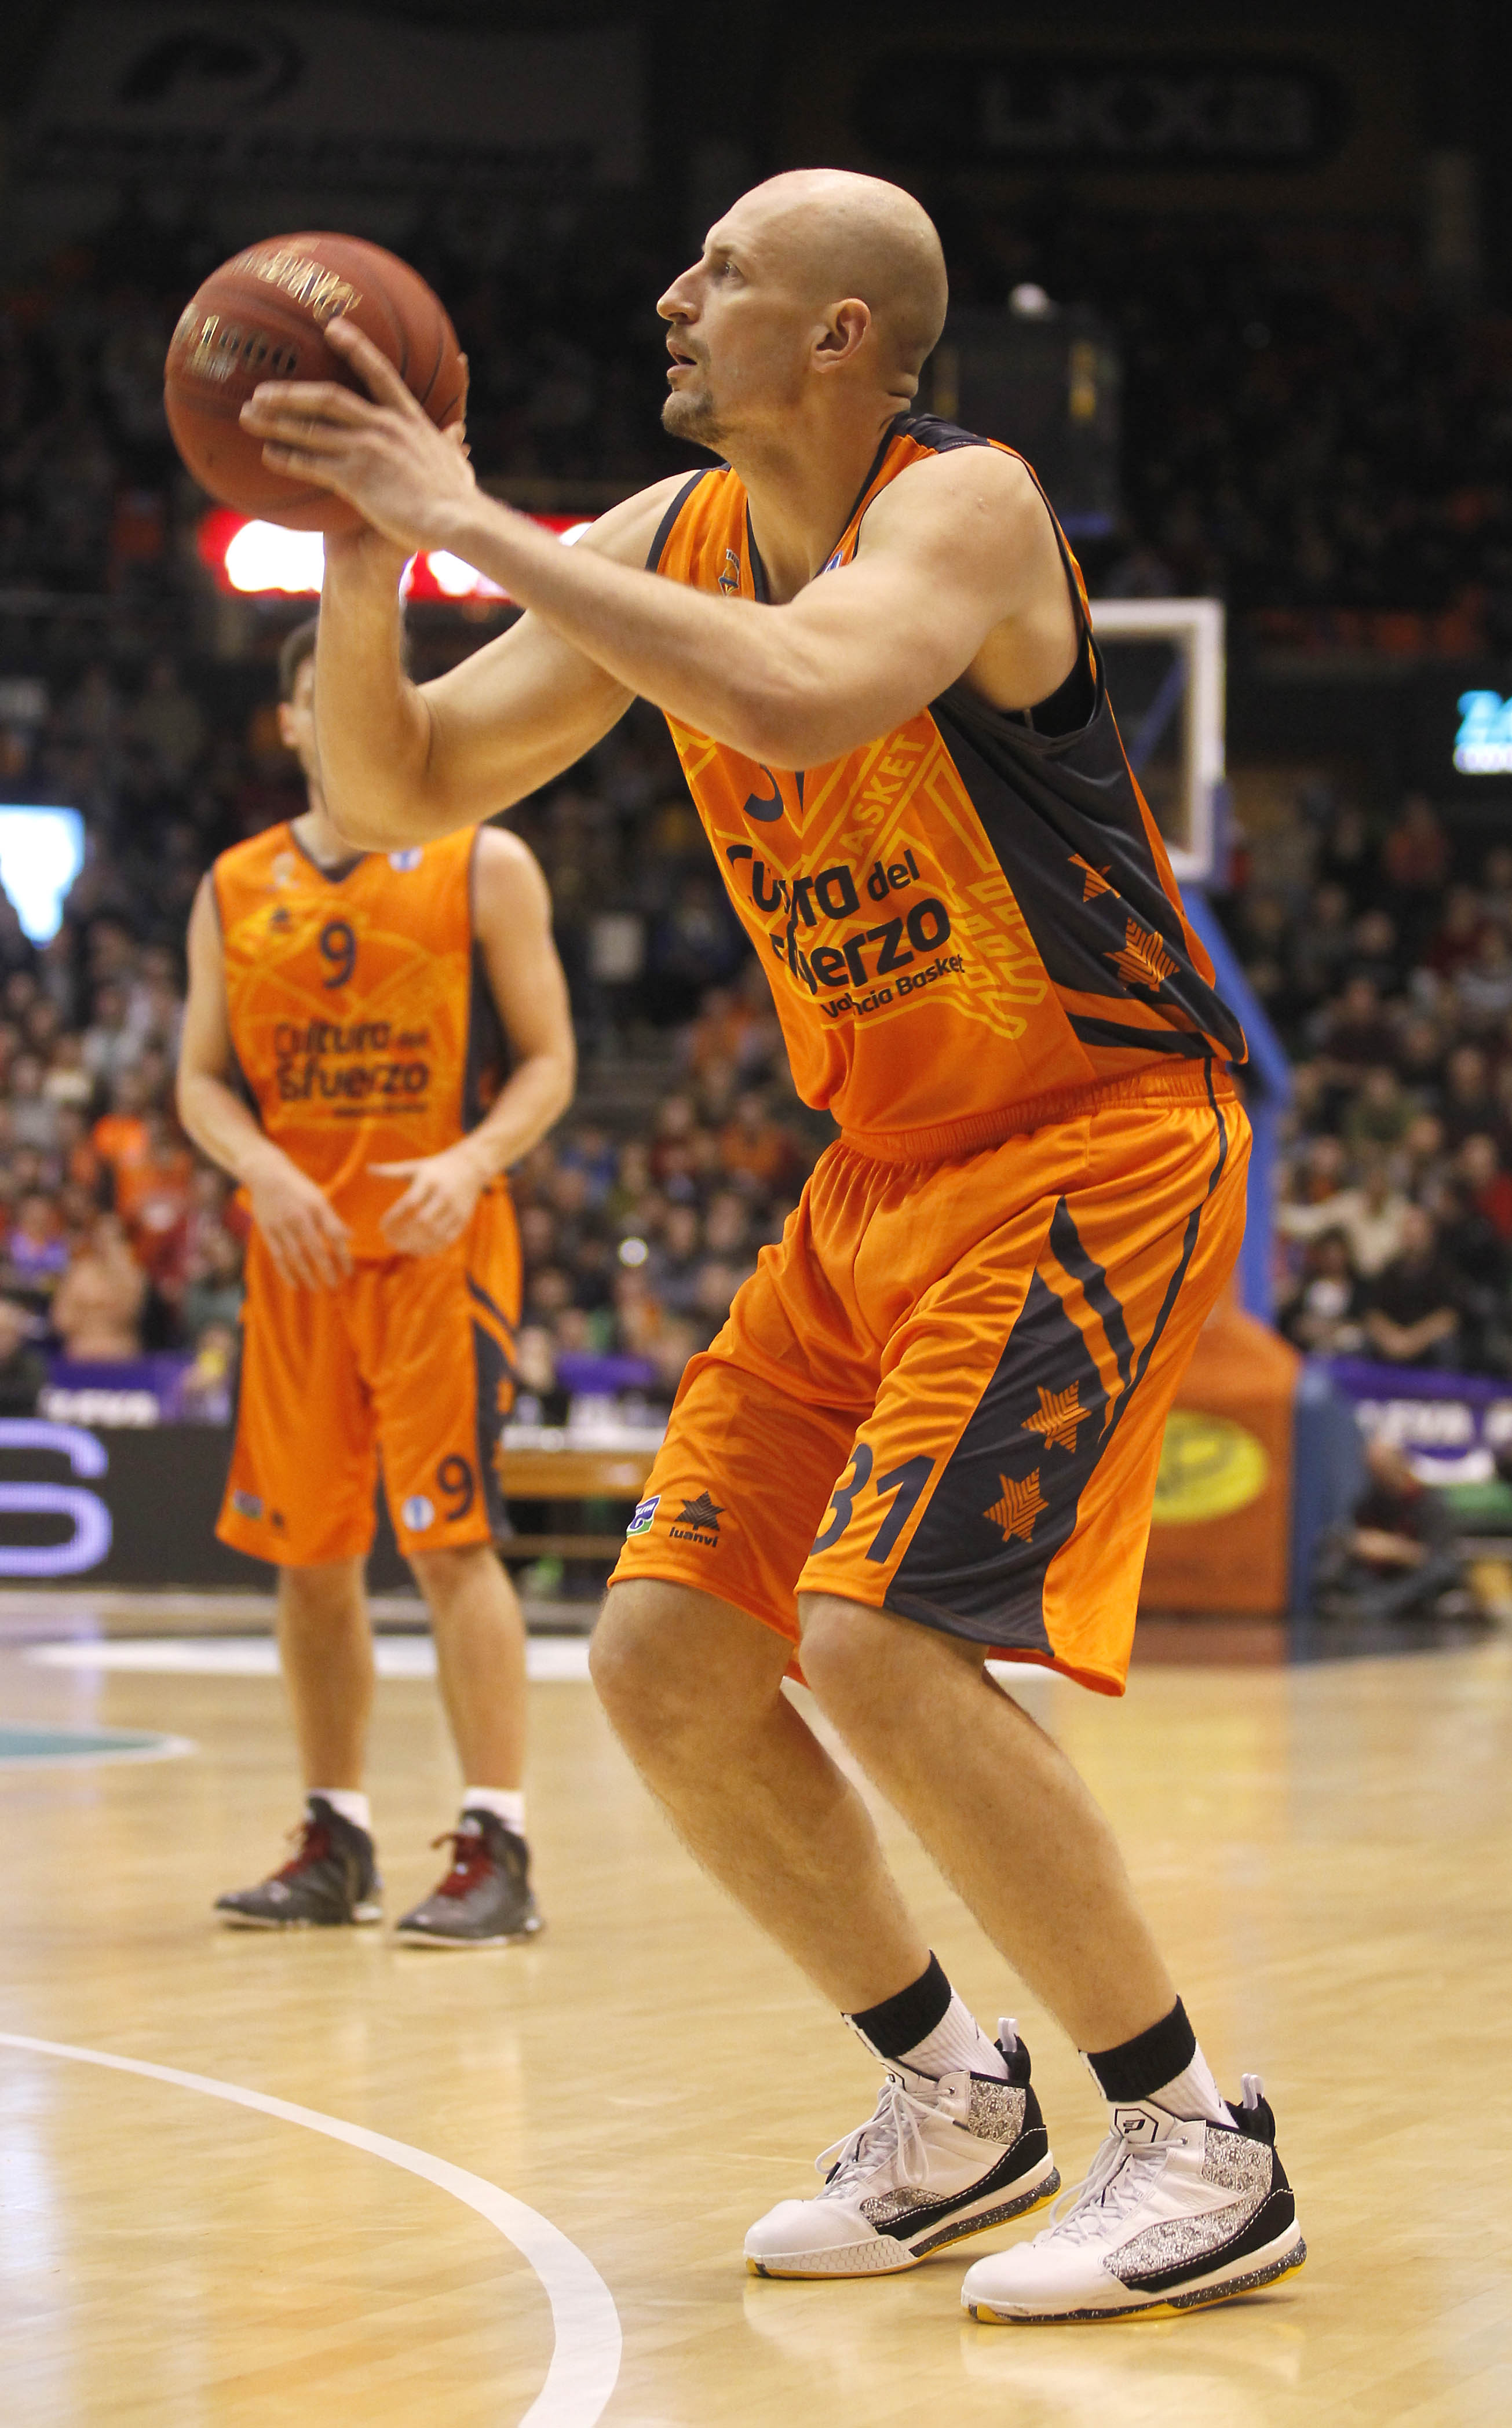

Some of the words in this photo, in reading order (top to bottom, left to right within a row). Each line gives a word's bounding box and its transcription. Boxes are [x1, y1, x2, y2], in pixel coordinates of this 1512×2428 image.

[867, 849, 920, 901] del
[320, 921, 356, 989] 9
[896, 954, 965, 996] Basket
[436, 1454, 474, 1521] 9
[810, 1443, 937, 1564] 31
[669, 1526, 719, 1548] luanvi
